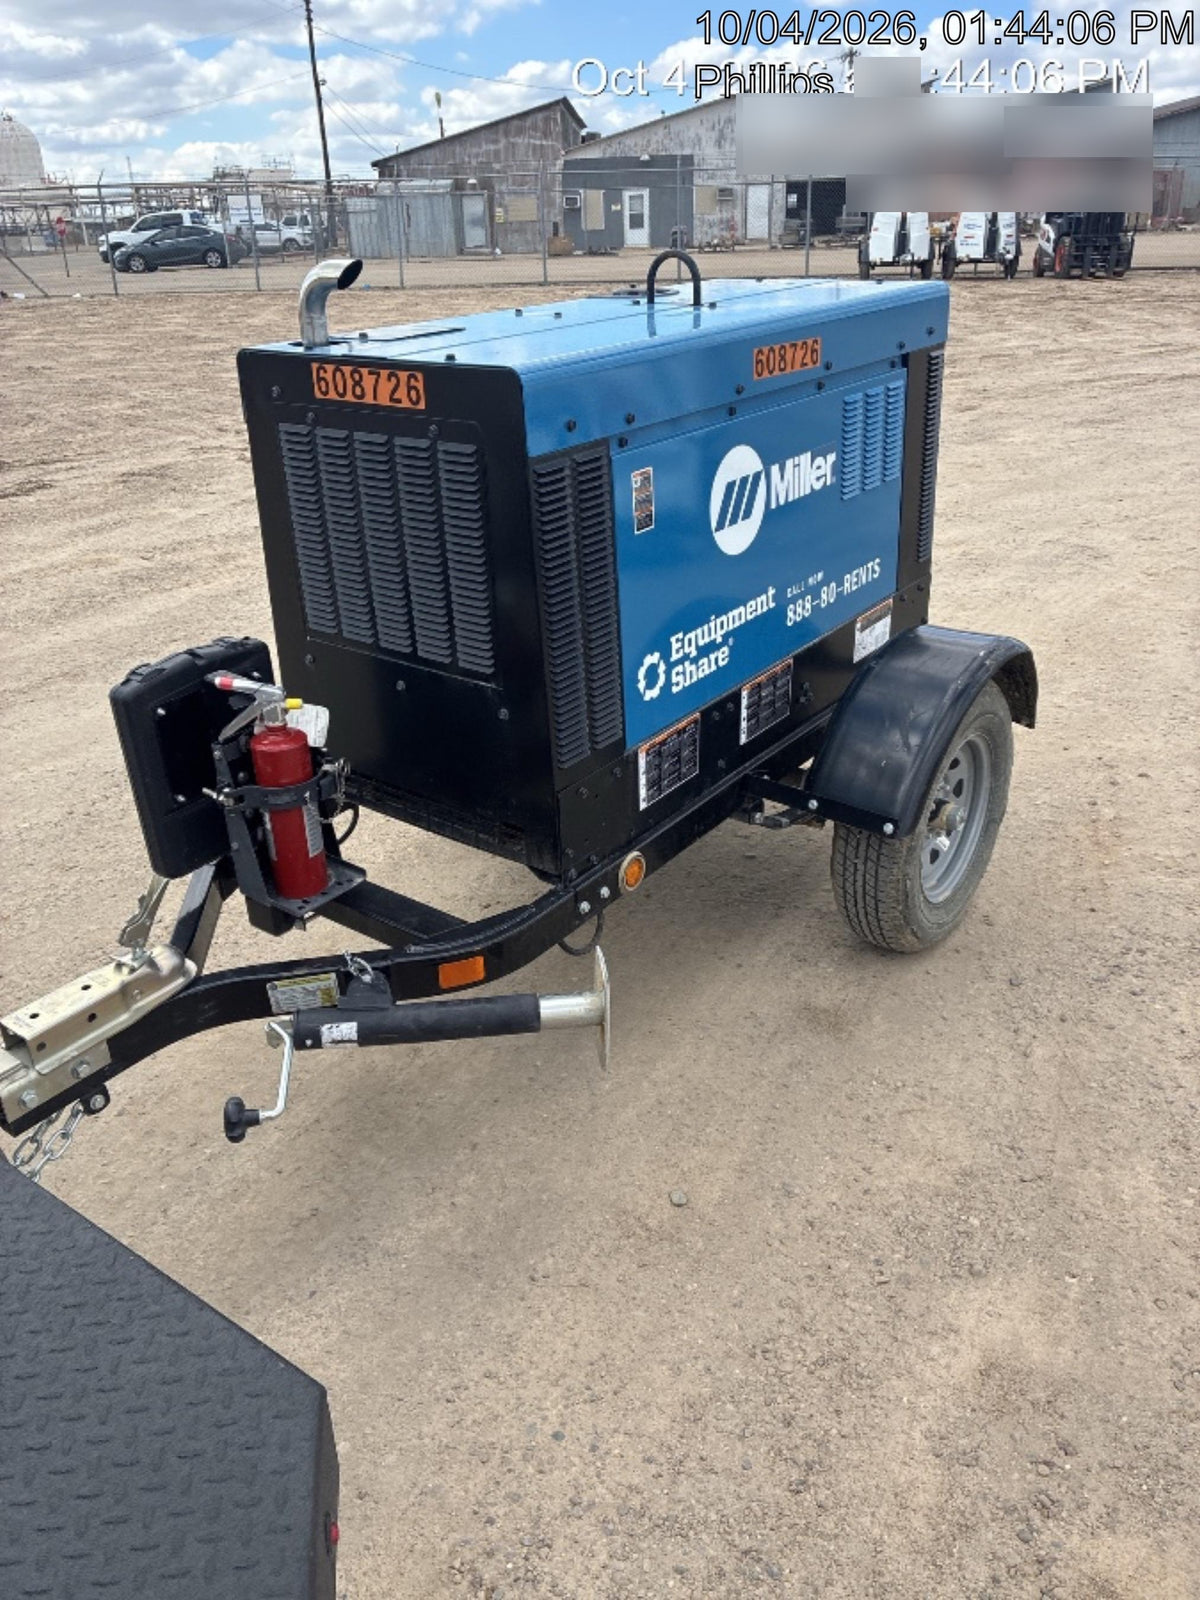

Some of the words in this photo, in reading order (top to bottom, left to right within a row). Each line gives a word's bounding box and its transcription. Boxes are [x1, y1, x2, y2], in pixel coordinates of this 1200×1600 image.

[315, 364, 422, 406] 608726
[754, 338, 820, 378] 608726
[770, 450, 837, 510] Miller
[786, 557, 881, 627] 888-80-RENTS
[670, 586, 776, 662] Equipment
[671, 645, 730, 694] Share
